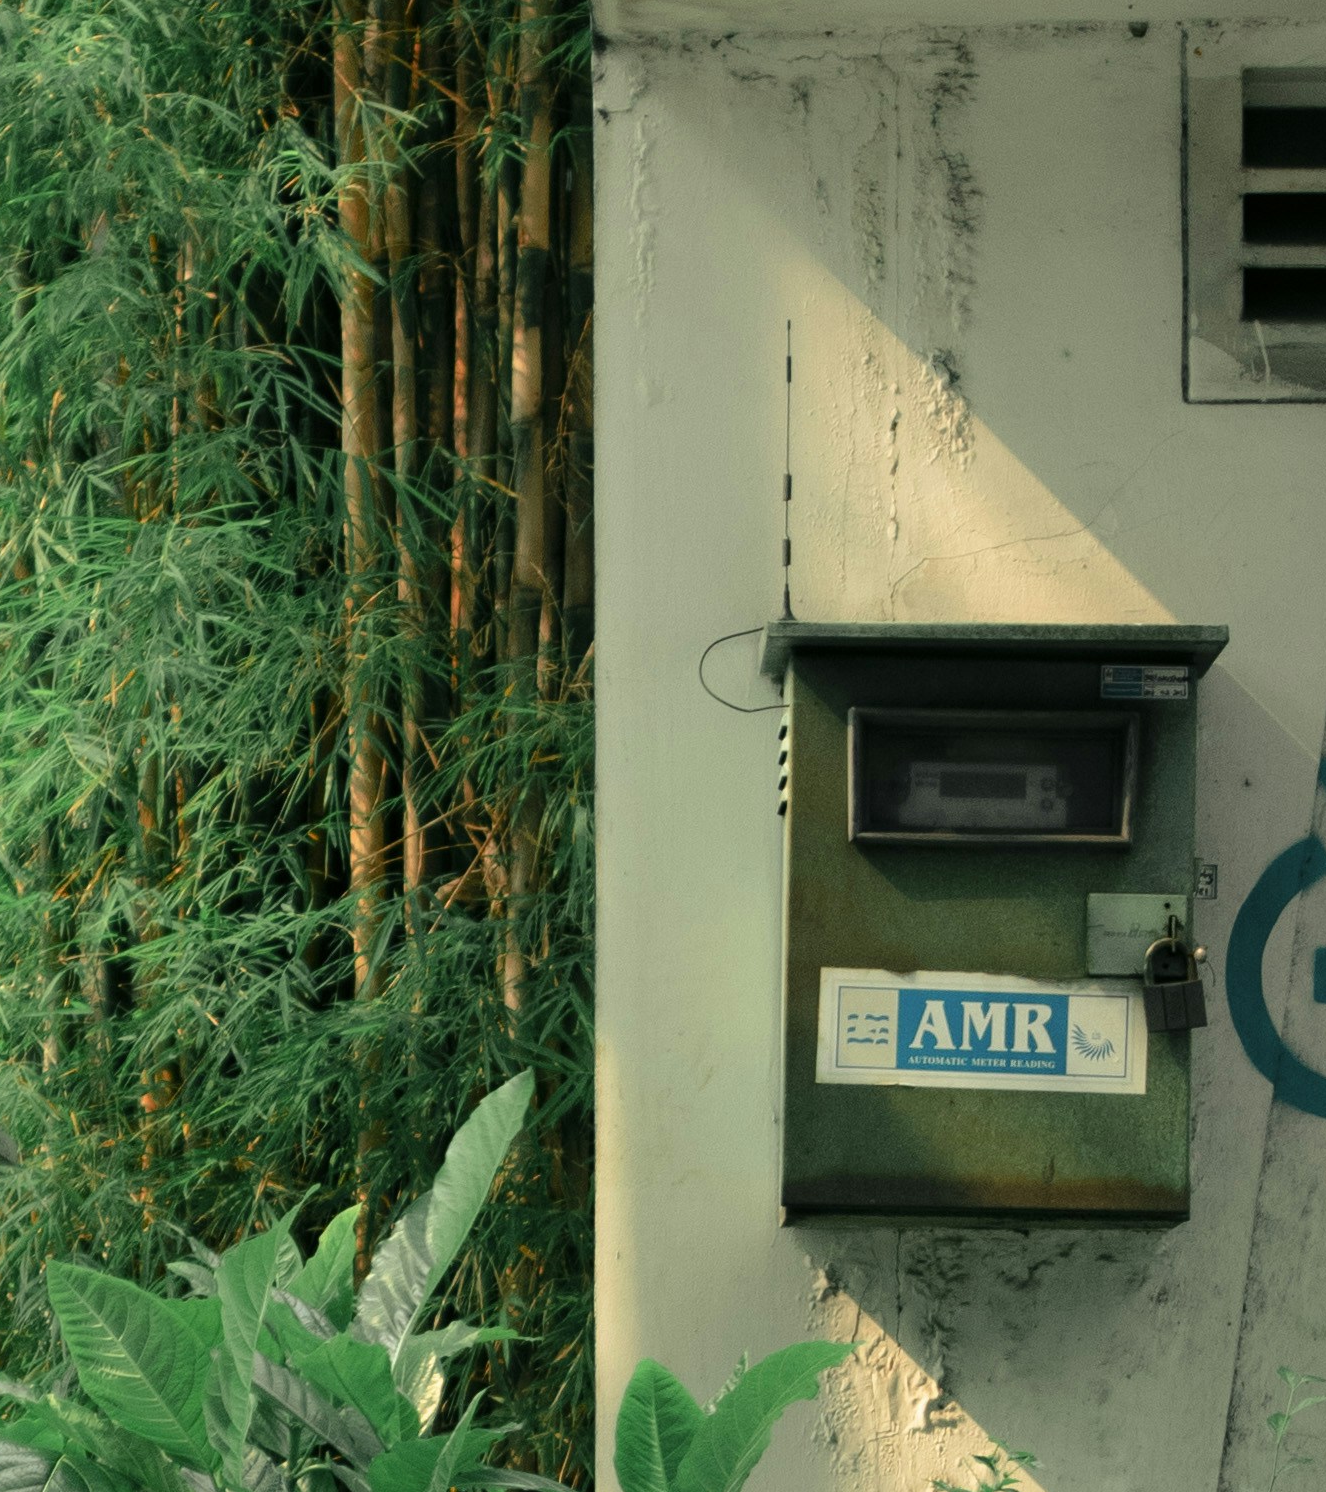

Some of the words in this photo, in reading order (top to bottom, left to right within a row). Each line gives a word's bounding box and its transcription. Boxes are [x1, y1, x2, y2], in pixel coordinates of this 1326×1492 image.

[908, 999, 1057, 1054] AMR
[907, 1055, 969, 1067] AUTOMATIC
[971, 1058, 1007, 1069] METER
[1009, 1059, 1056, 1070] READING
